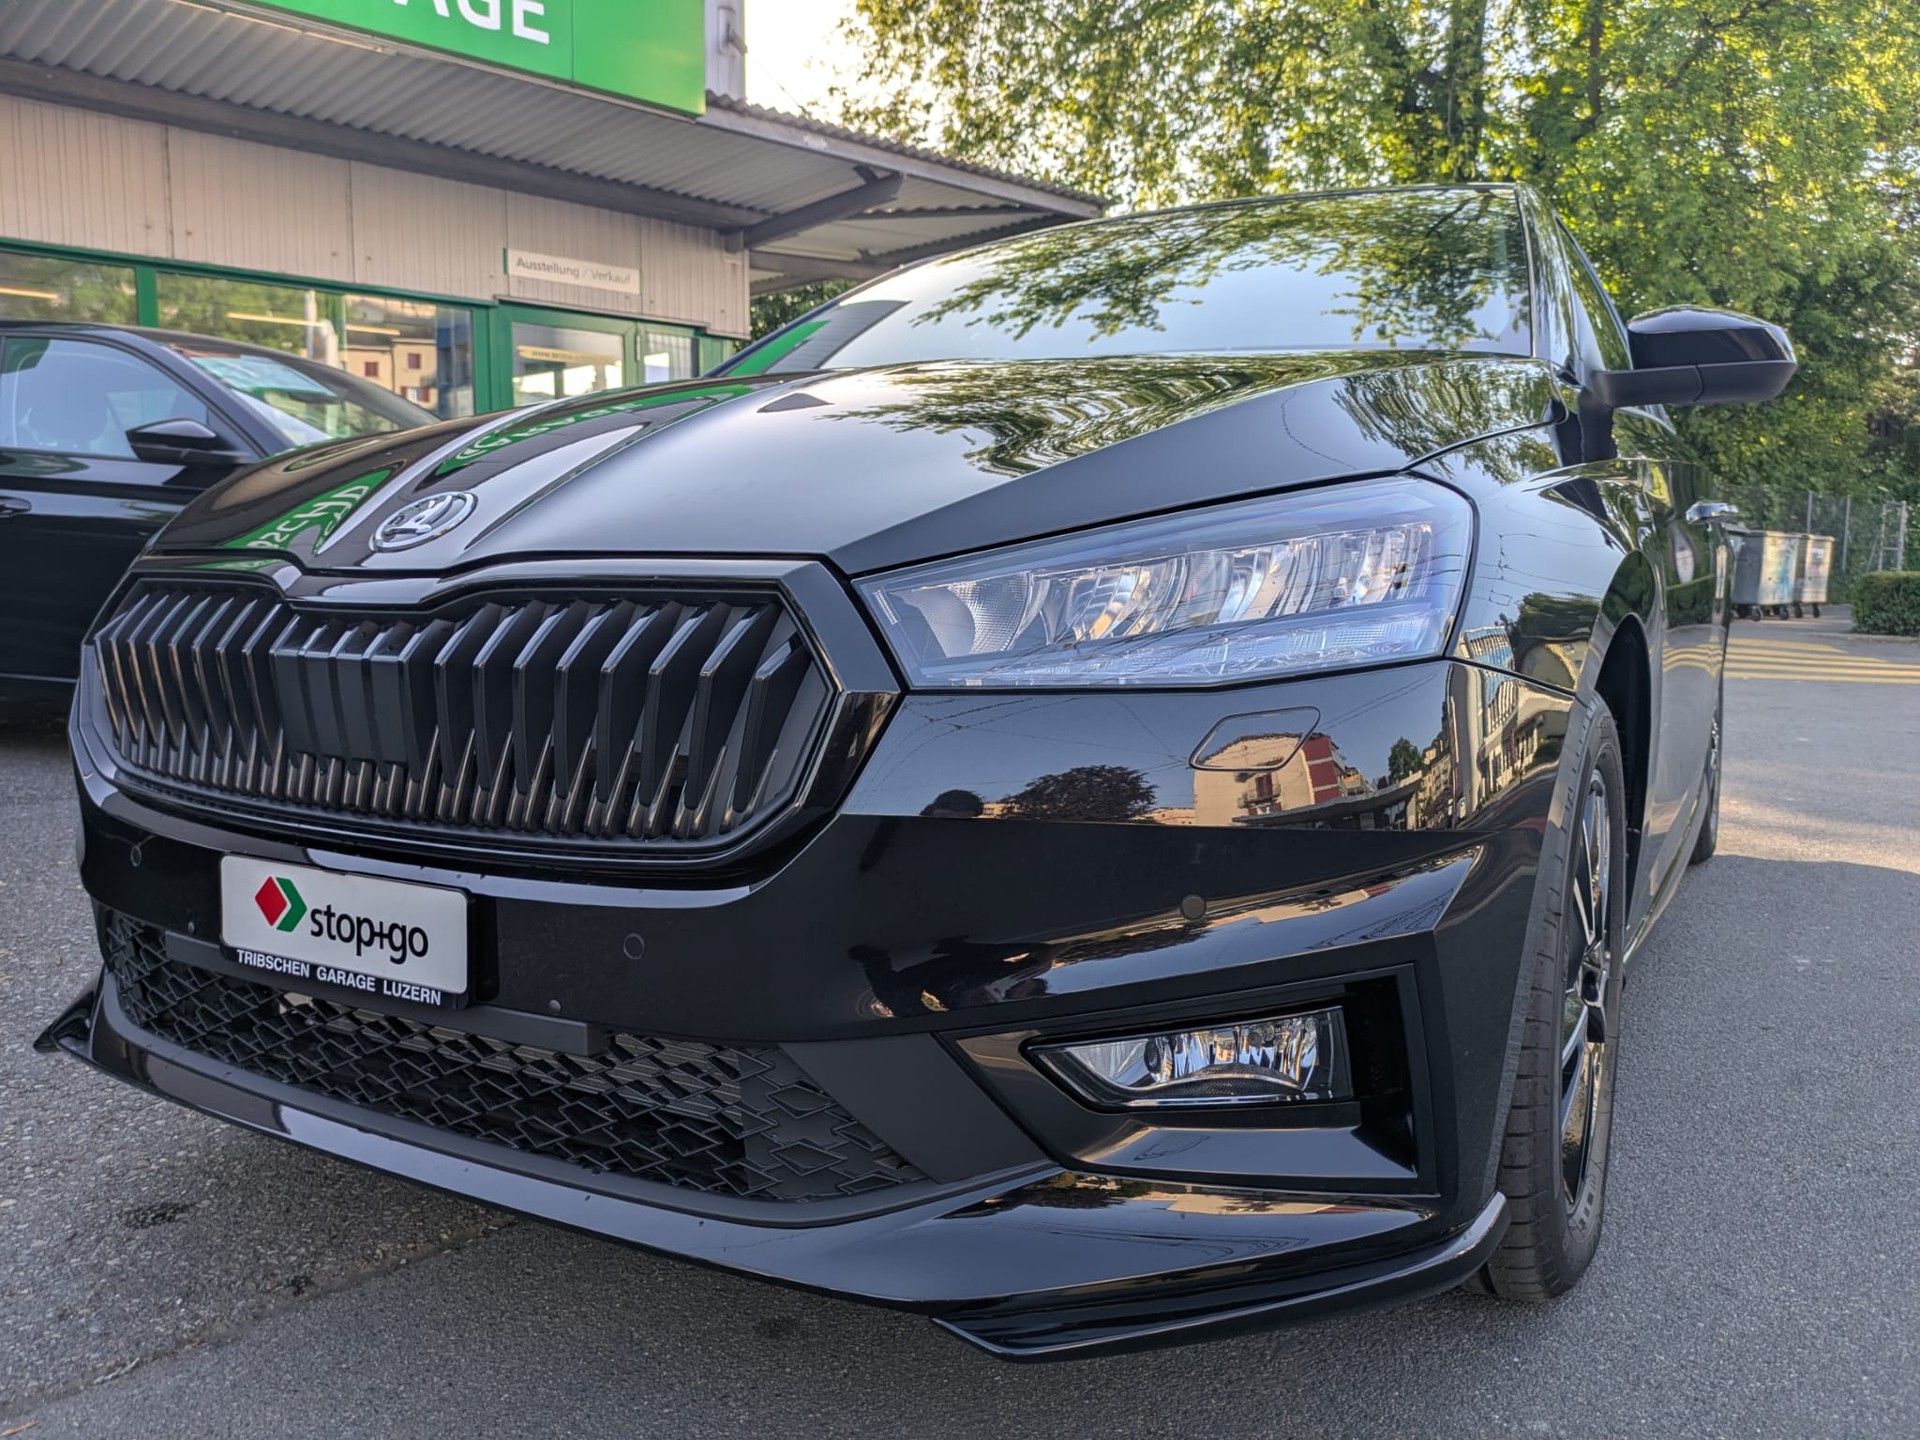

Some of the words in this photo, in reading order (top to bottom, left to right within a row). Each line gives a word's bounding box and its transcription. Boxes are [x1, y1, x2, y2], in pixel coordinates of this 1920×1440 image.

[517, 257, 580, 279] Ausstellung
[590, 269, 631, 285] Verkauf
[310, 904, 429, 964] stop+go
[237, 949, 310, 978] TRIBSCHEN
[317, 966, 376, 991] GARAGE
[383, 980, 442, 1006] LUZERN
